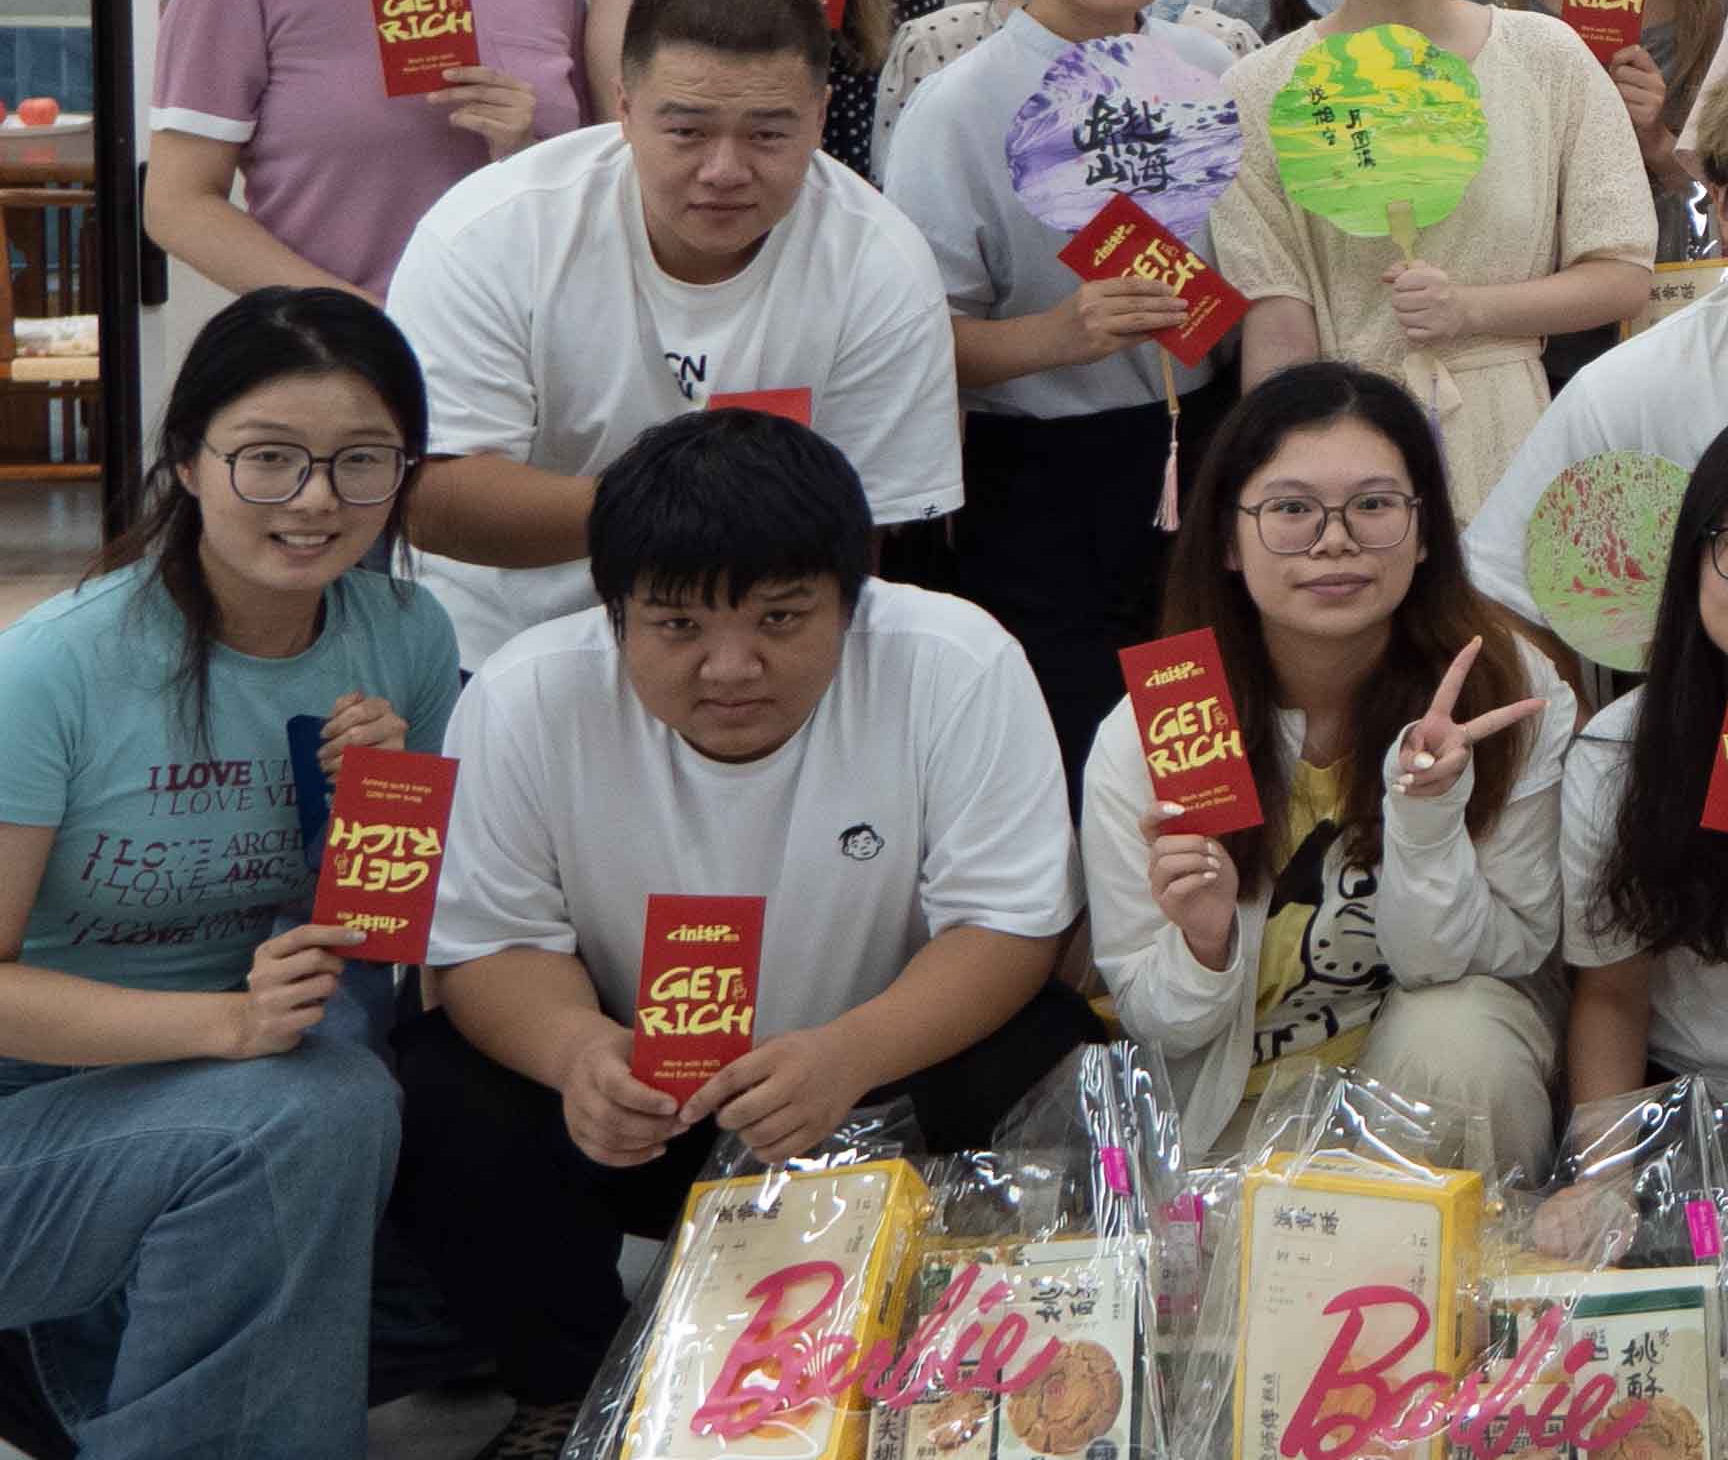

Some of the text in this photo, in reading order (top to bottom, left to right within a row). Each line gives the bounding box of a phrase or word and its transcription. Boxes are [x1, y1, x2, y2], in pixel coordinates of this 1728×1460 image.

[377, 11, 472, 43] RICH
[1147, 696, 1217, 745] GET
[1144, 729, 1242, 778] RICH
[165, 761, 252, 791] LOVE
[169, 786, 254, 815] LOVE
[328, 817, 441, 857] RICH
[336, 853, 428, 892] GET
[649, 965, 742, 1002] GET
[637, 1002, 753, 1036] RICH
[1280, 1285, 1651, 1460] Barbie
[1620, 1331, 1665, 1400] 桃酥
